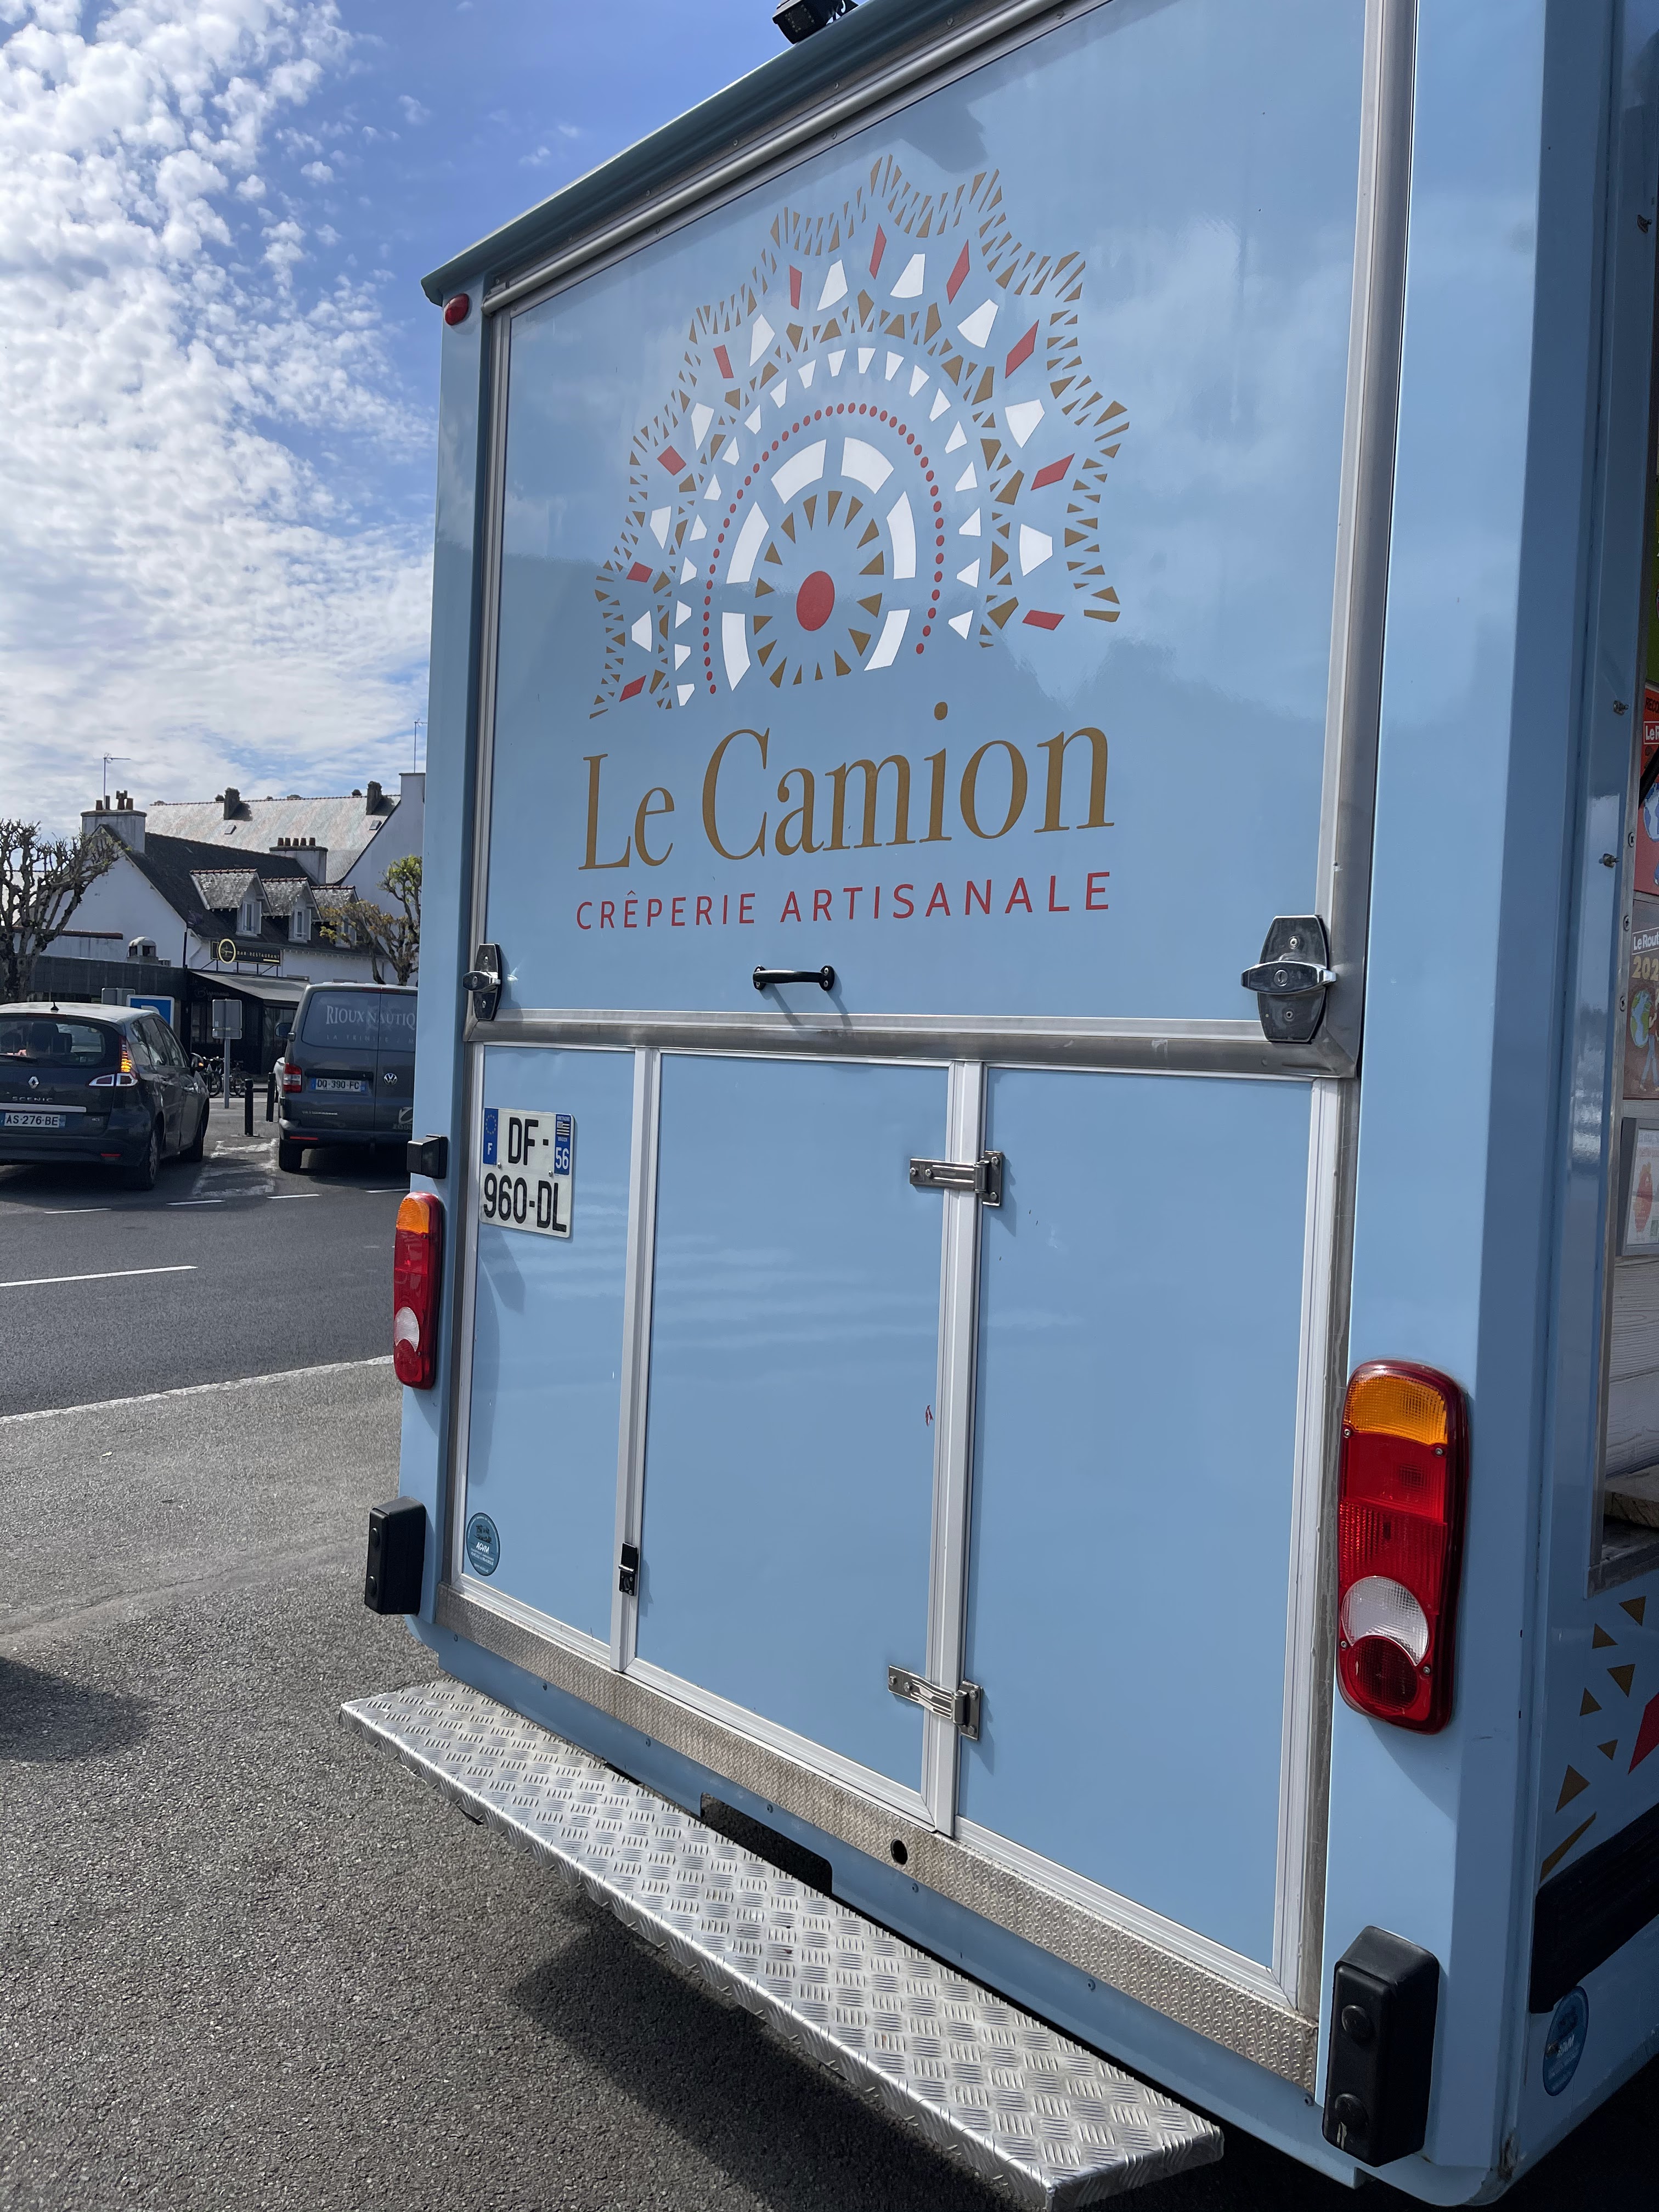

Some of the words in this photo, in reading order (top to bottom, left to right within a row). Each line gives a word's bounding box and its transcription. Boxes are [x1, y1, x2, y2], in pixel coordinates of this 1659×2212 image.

[578, 753, 675, 871] Le
[702, 701, 1114, 860] Camion
[577, 890, 755, 930] CRÊPERIE
[780, 871, 1110, 923] ARTISANALE
[326, 1005, 364, 1025] RIOUX
[6, 1115, 59, 1126] AS-276-BE
[487, 1142, 493, 1155] F
[555, 1147, 569, 1170] 56
[483, 1172, 567, 1233] 960-DL
